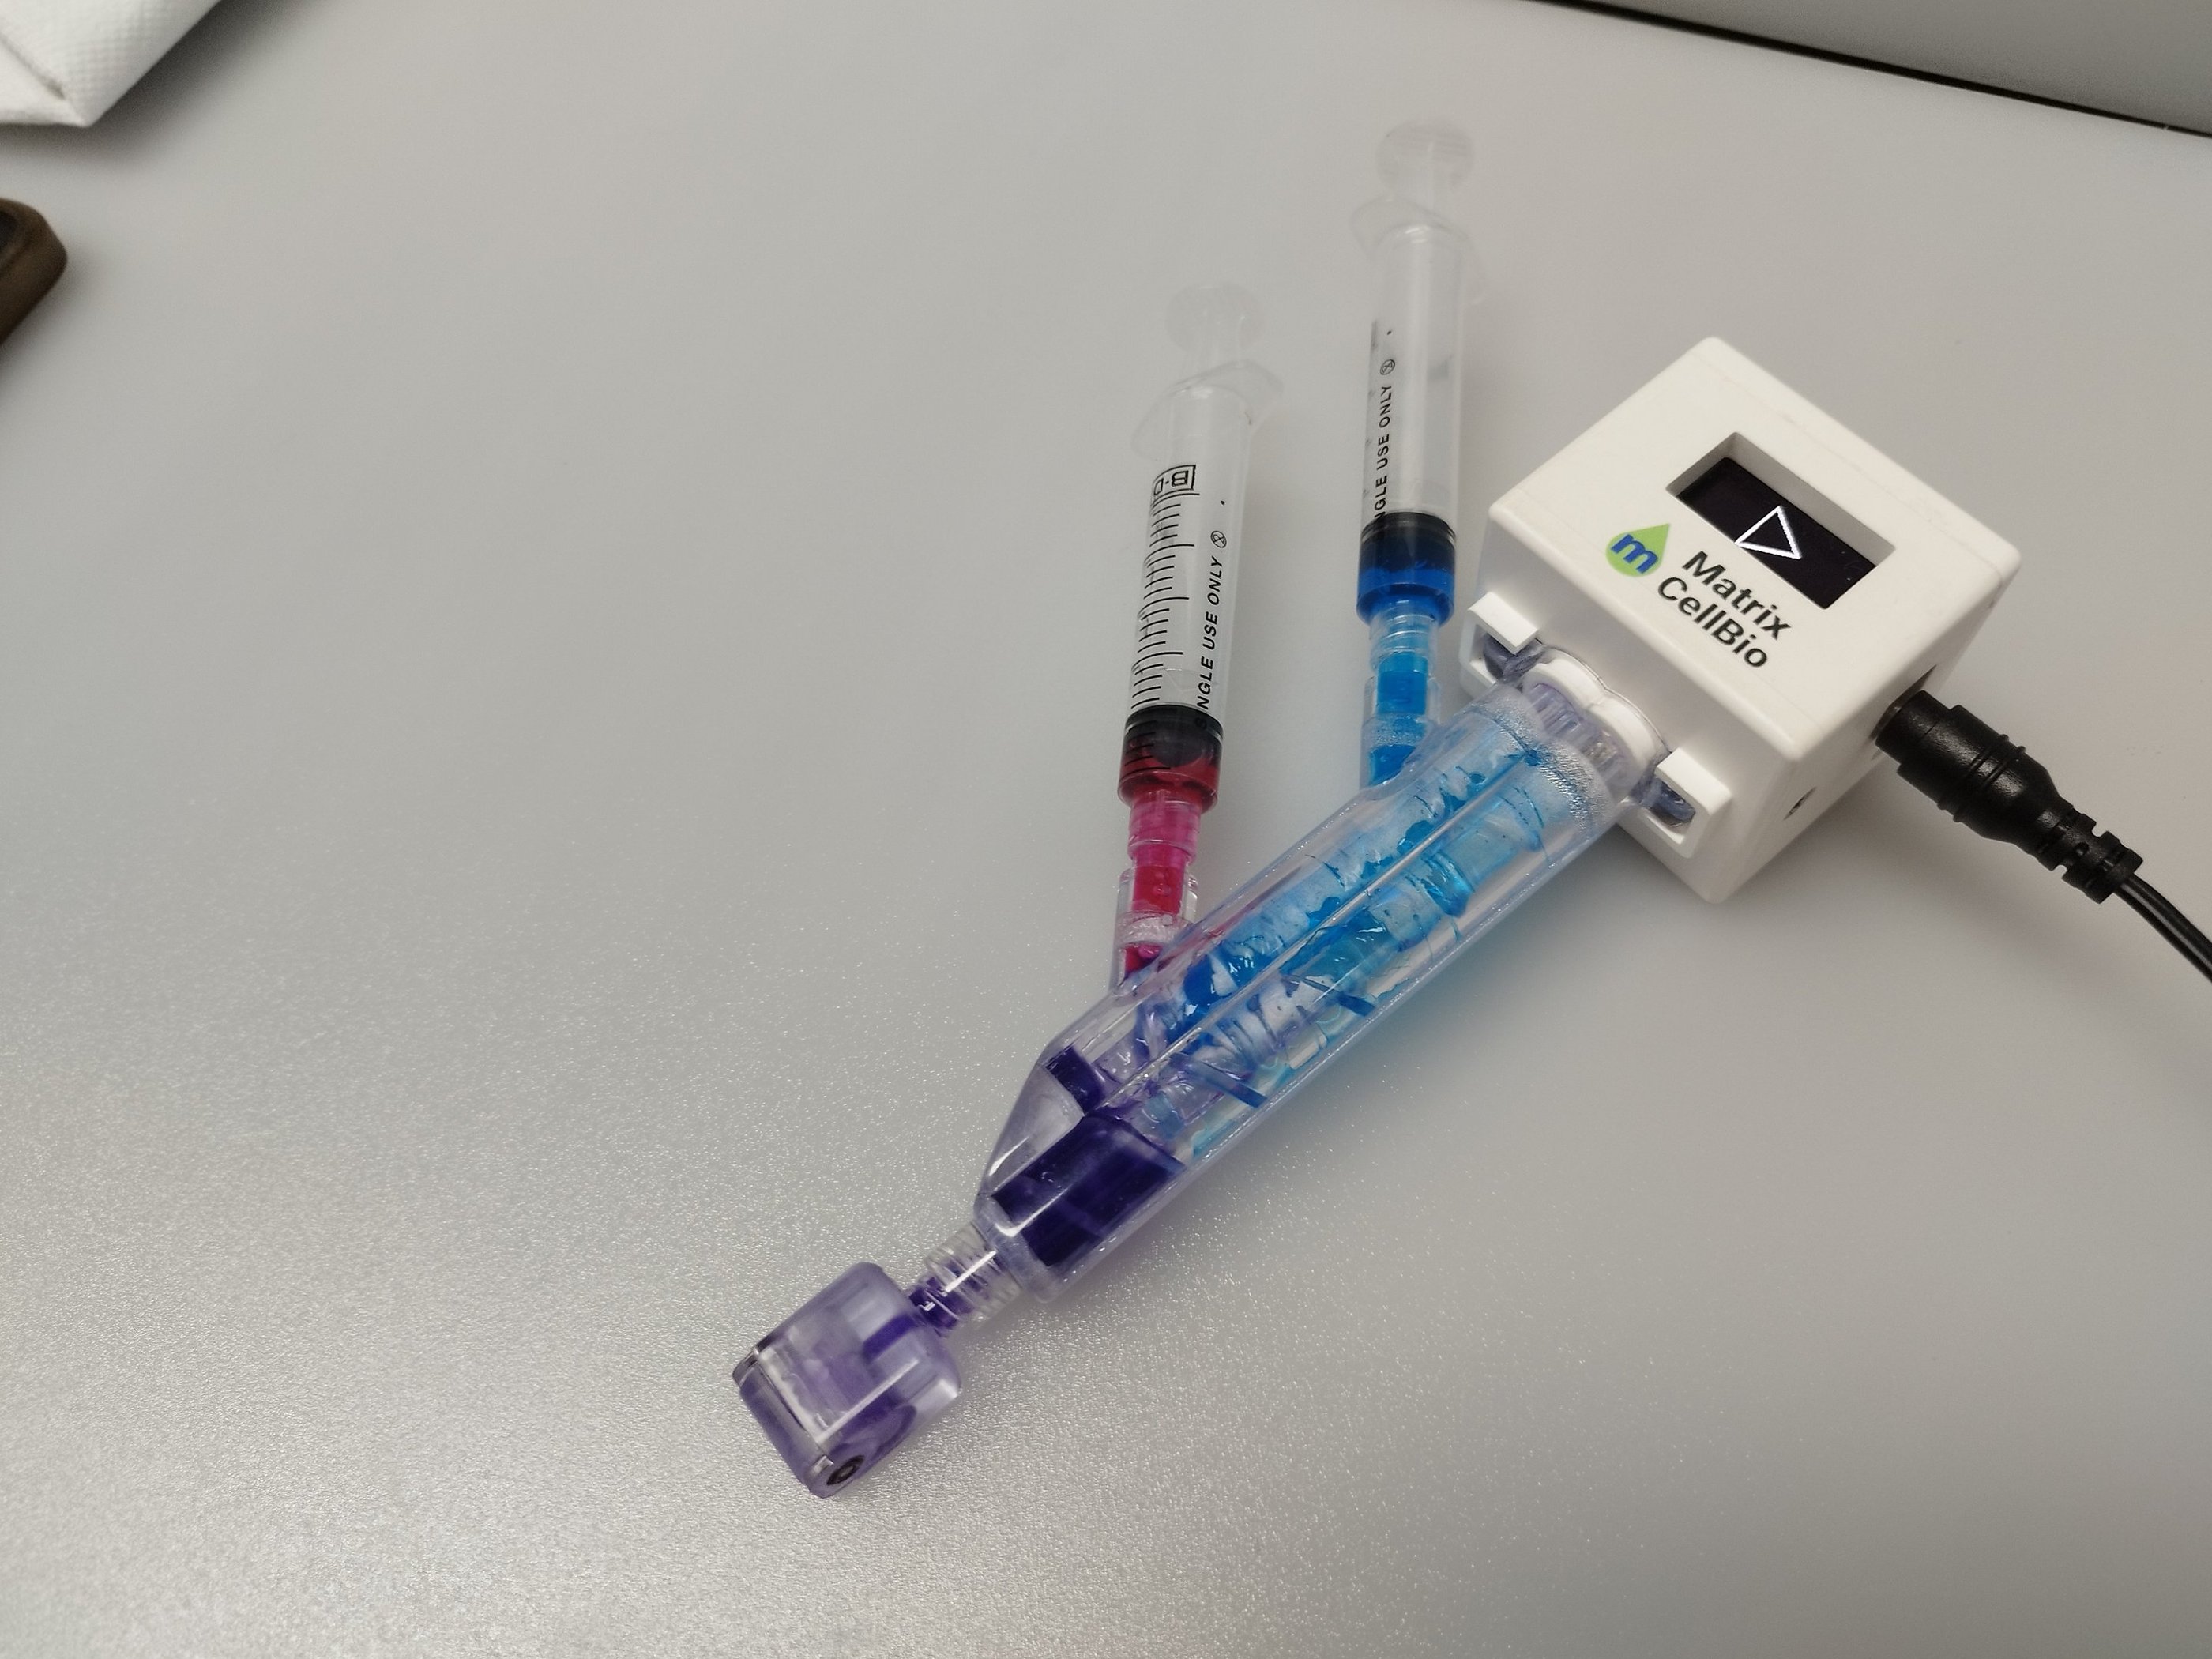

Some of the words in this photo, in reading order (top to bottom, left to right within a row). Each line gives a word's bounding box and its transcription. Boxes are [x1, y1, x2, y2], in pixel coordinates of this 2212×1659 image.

[1379, 385, 1392, 428] ONLY
[1377, 434, 1390, 471] USE
[1610, 532, 1658, 574] m
[1207, 555, 1224, 606] ONLY
[1682, 551, 1791, 640] Matrix
[1202, 611, 1218, 652] USE
[1658, 577, 1768, 668] CellBio
